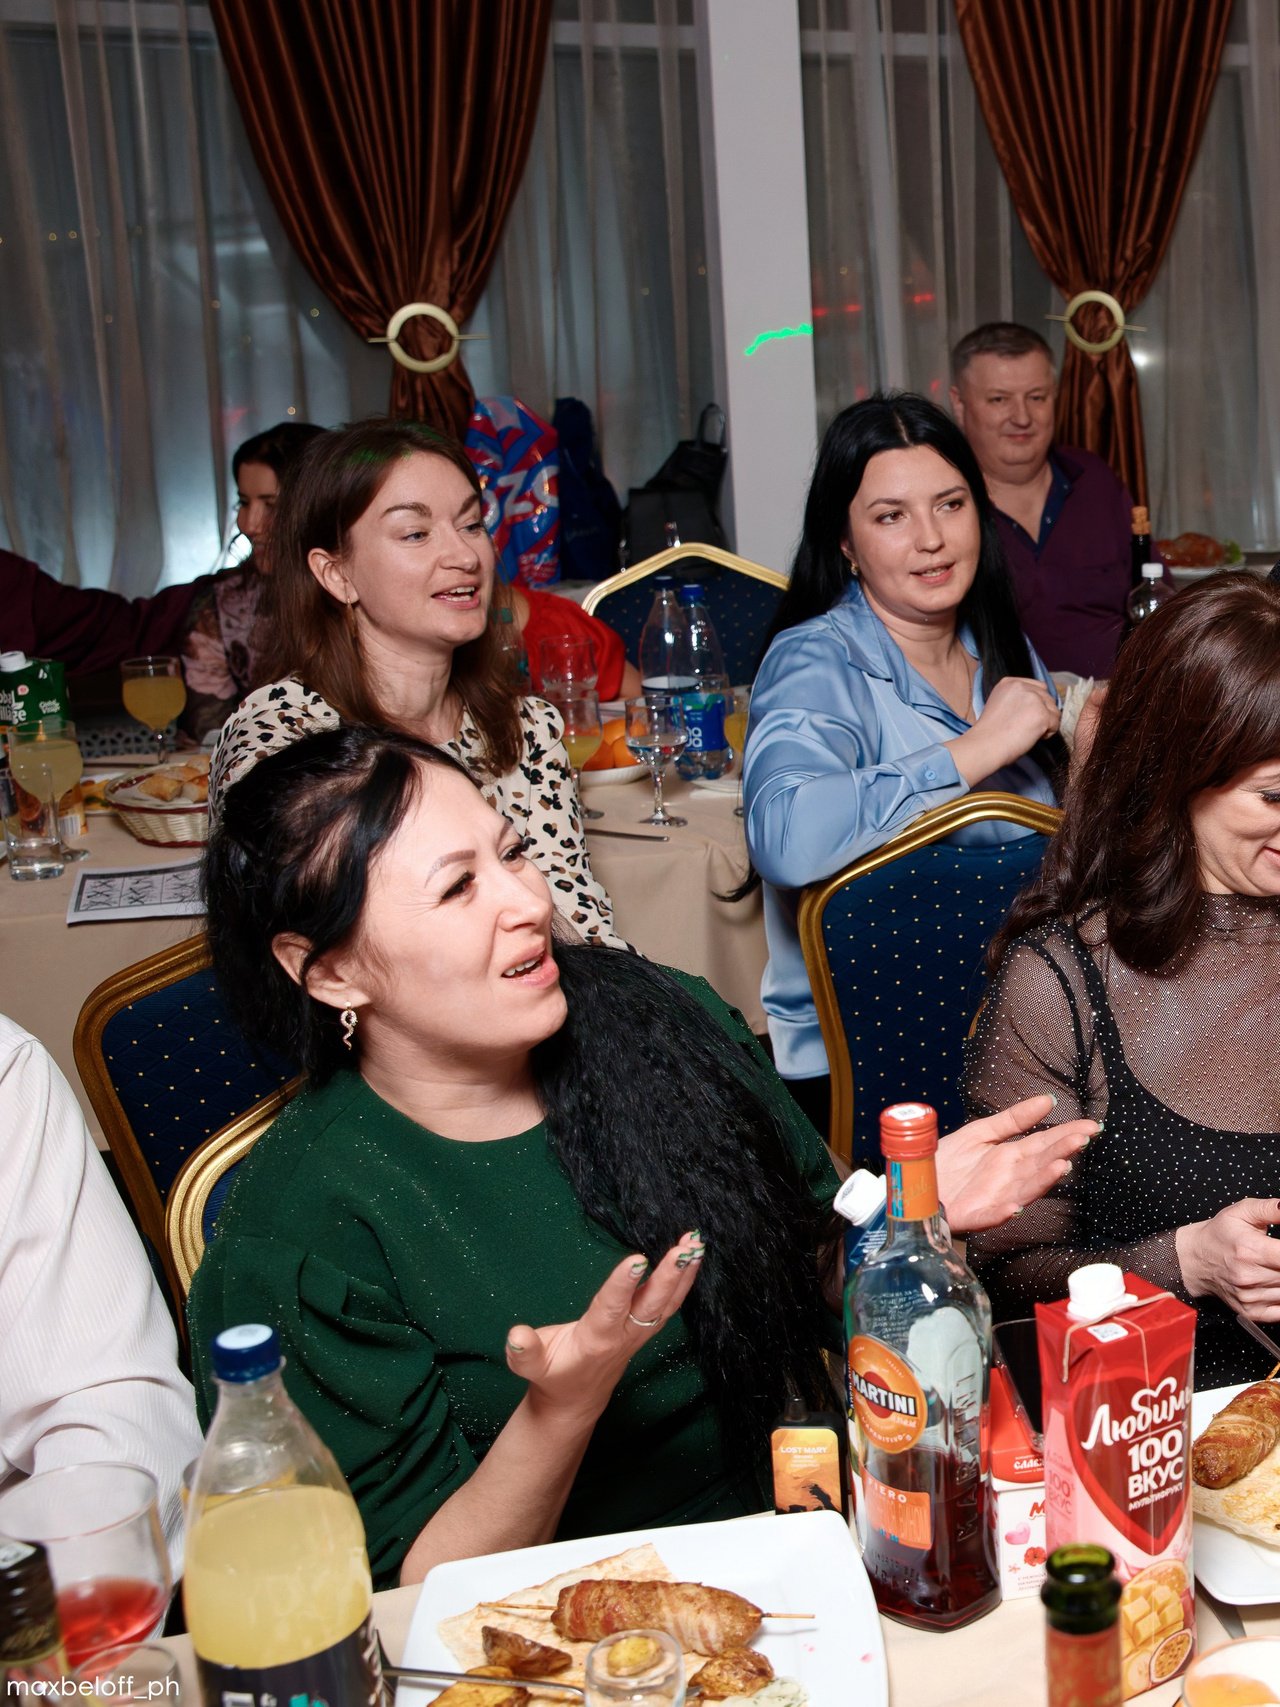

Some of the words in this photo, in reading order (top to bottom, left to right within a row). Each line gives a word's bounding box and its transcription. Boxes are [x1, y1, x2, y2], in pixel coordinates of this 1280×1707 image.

[852, 1371, 916, 1416] MARTINI
[780, 1446, 802, 1454] LOST
[804, 1446, 828, 1454] MARY
[868, 1478, 908, 1503] FIERO
[1128, 1457, 1184, 1499] ВКУС
[1128, 1482, 1184, 1511] МУЛЬТИФРУКТ
